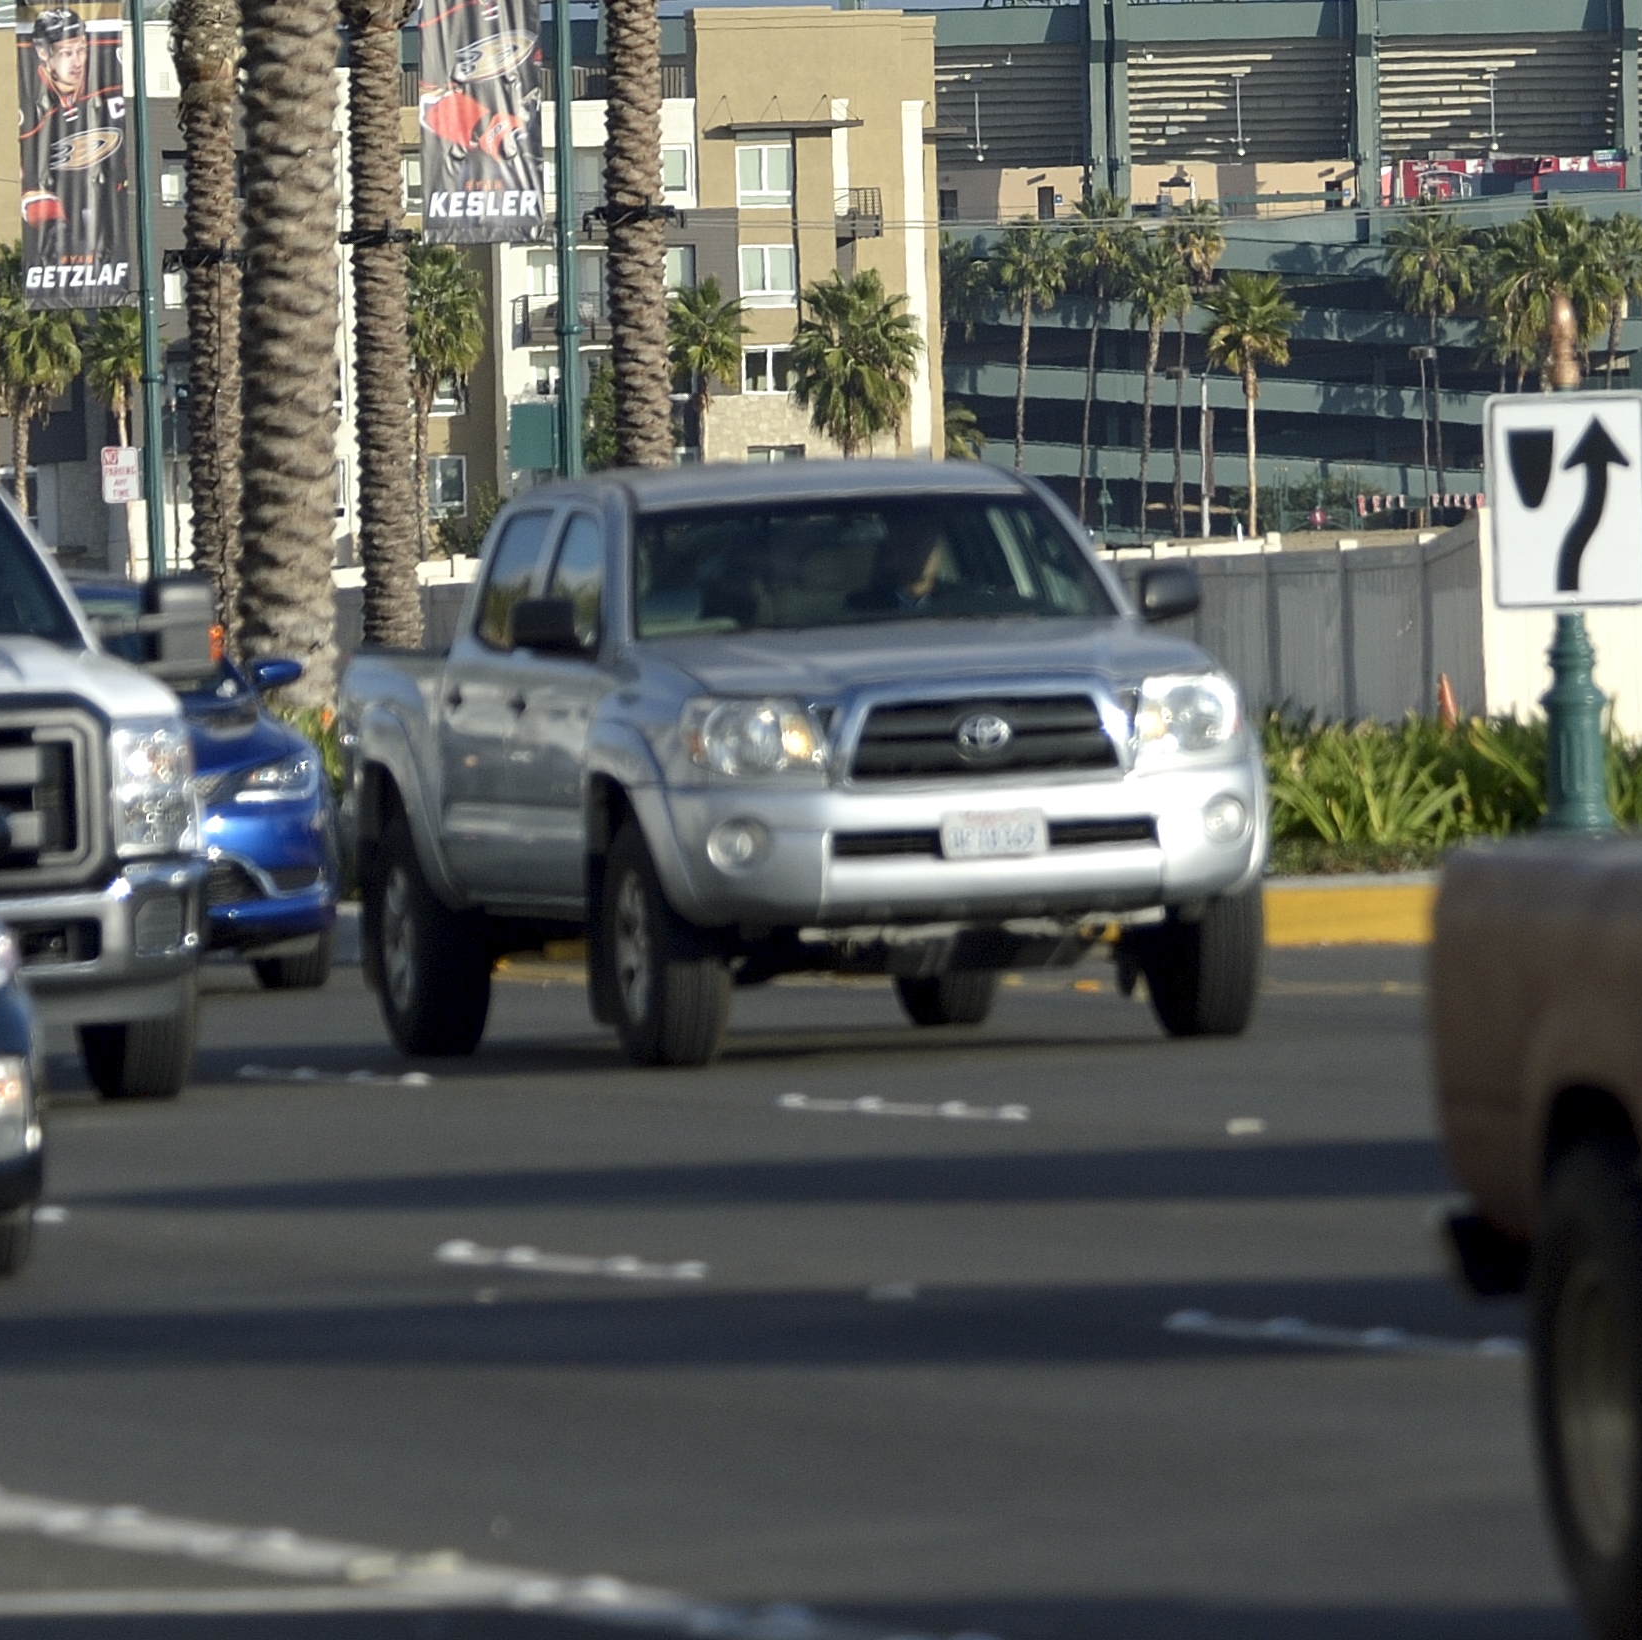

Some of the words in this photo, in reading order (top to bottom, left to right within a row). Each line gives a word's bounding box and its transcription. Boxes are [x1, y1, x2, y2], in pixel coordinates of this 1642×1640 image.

[429, 190, 538, 218] KESLER
[25, 262, 129, 289] GETZLAF
[104, 450, 117, 465] NO
